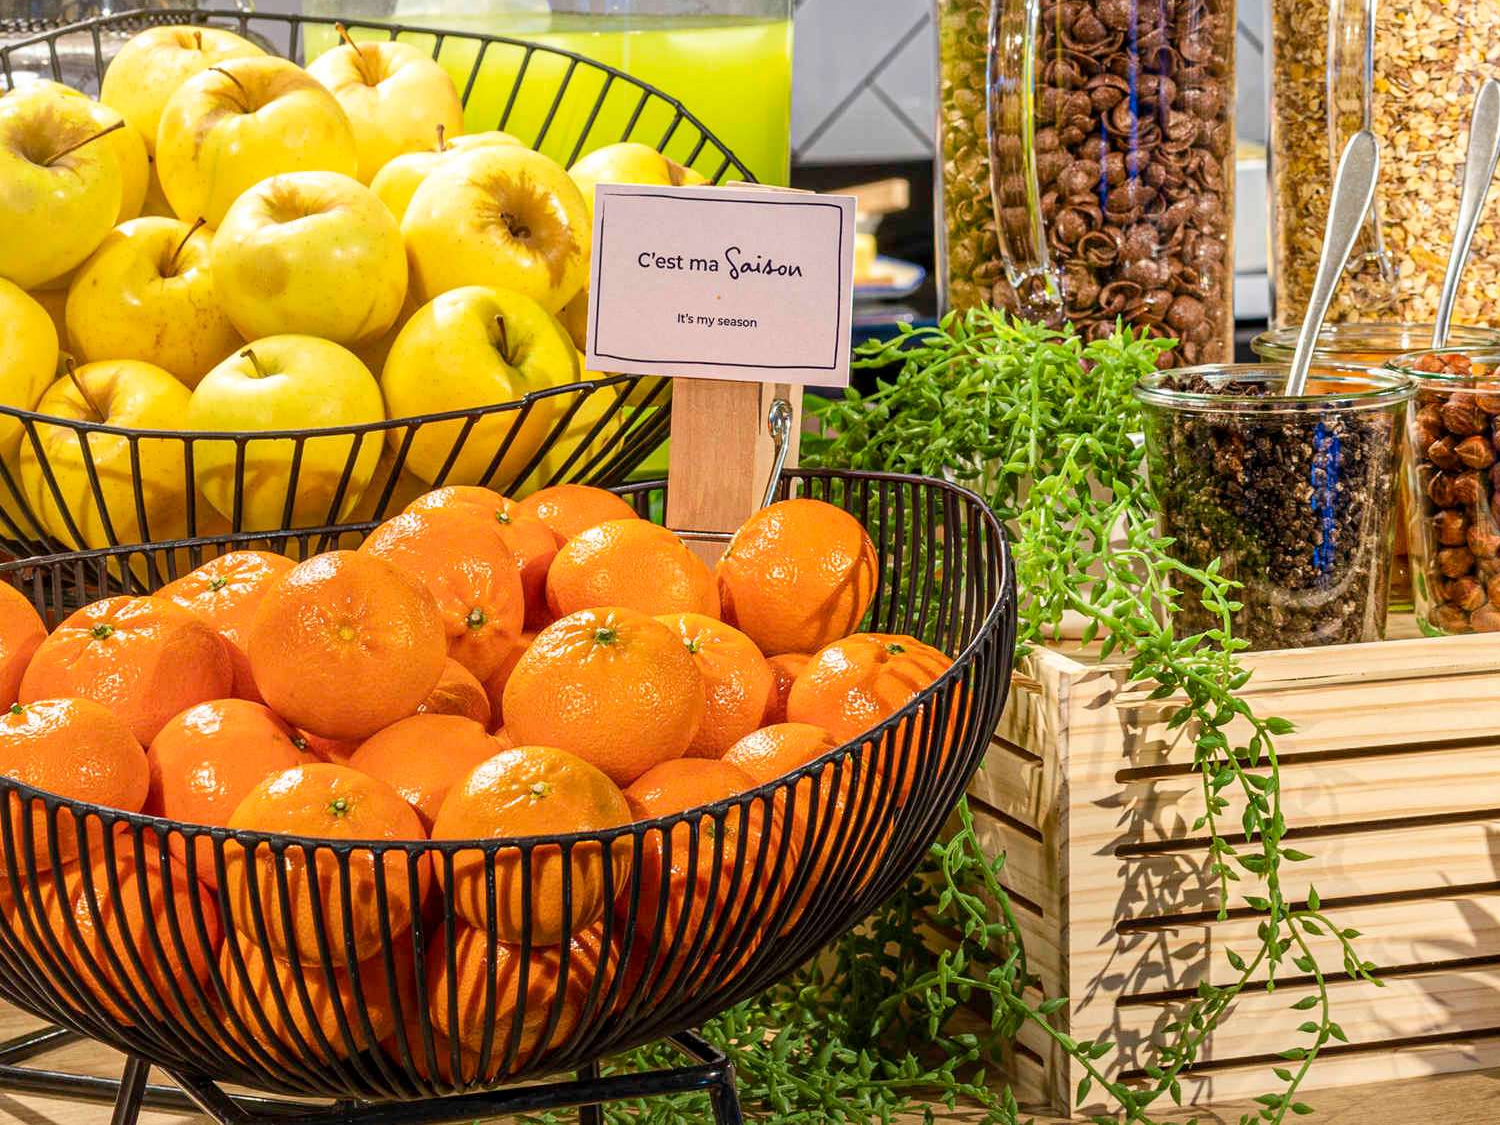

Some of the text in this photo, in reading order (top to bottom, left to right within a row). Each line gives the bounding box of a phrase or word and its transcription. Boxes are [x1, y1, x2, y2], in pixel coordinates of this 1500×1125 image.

[638, 246, 803, 279] C'est ma Saison
[677, 313, 758, 328] It's my season
